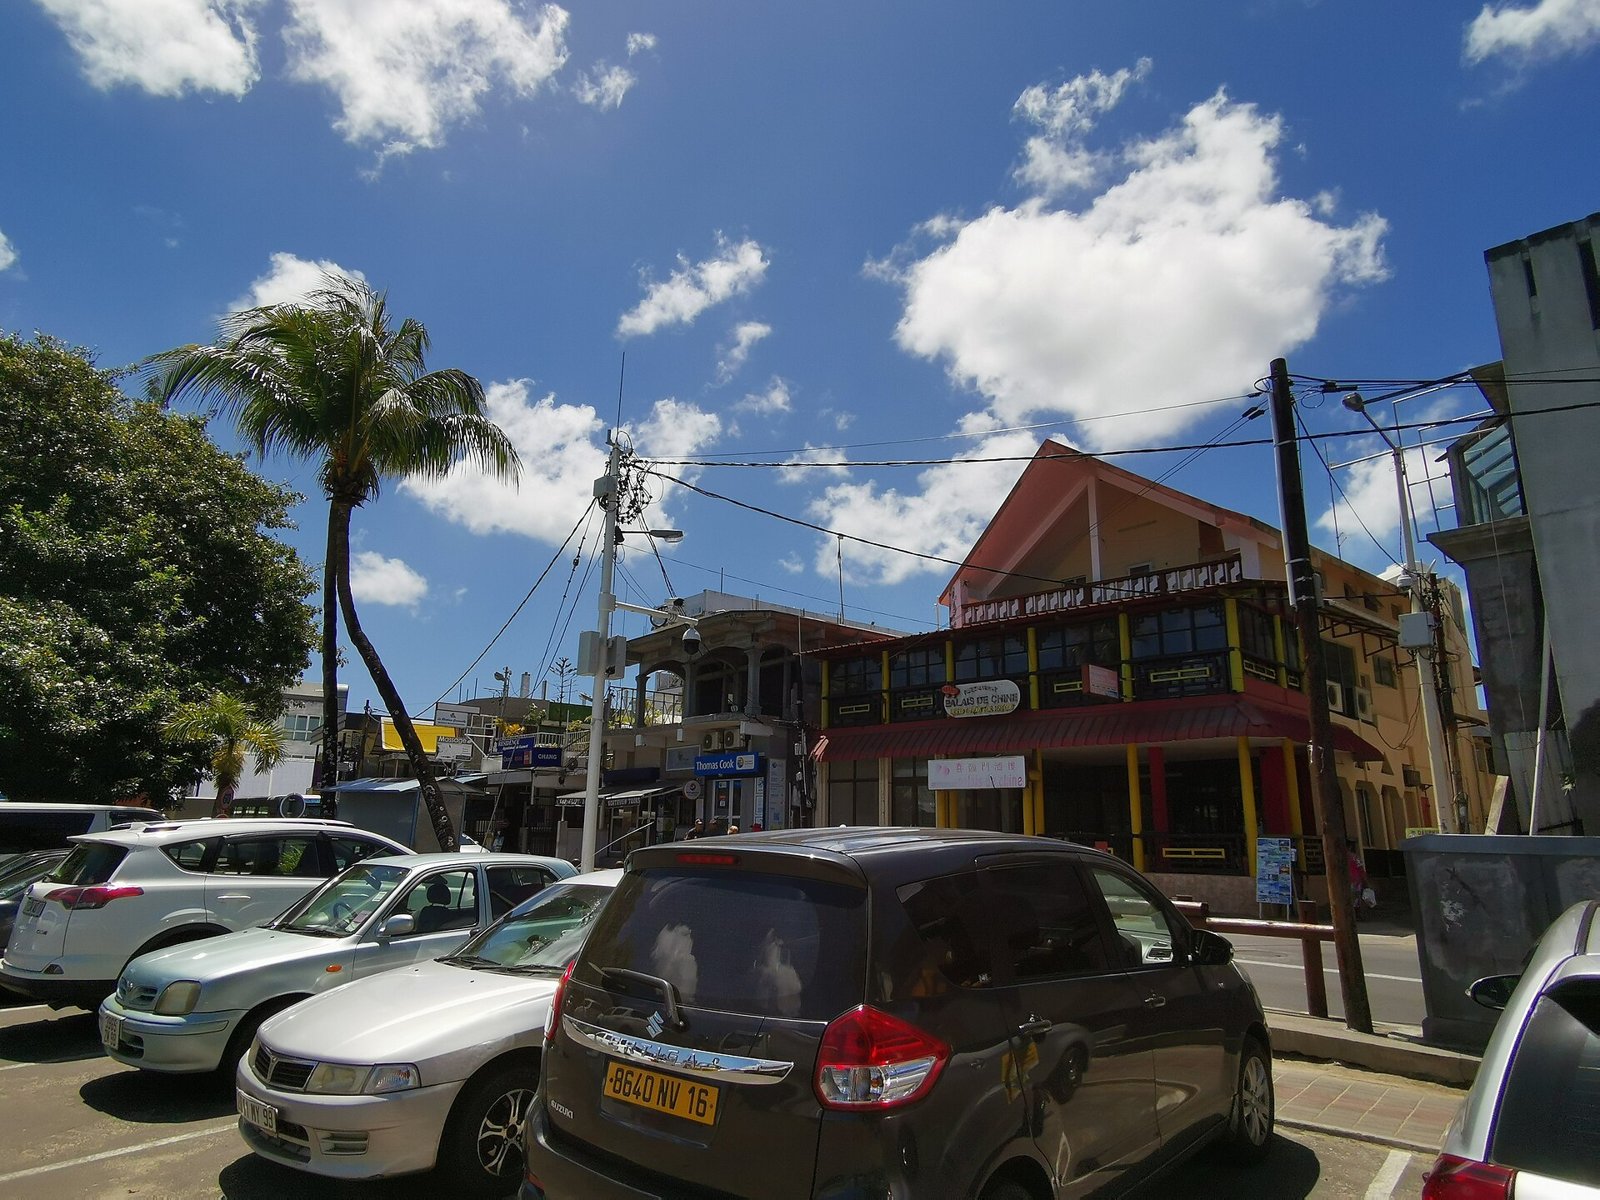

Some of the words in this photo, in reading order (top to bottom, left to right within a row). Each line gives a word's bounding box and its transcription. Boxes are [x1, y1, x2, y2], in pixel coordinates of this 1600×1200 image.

[696, 761, 719, 770] Thomas
[719, 759, 735, 769] Cook
[612, 1067, 655, 1103] 8640
[656, 1078, 681, 1110] NV
[688, 1085, 708, 1118] 16
[550, 1099, 575, 1119] SUZUKI
